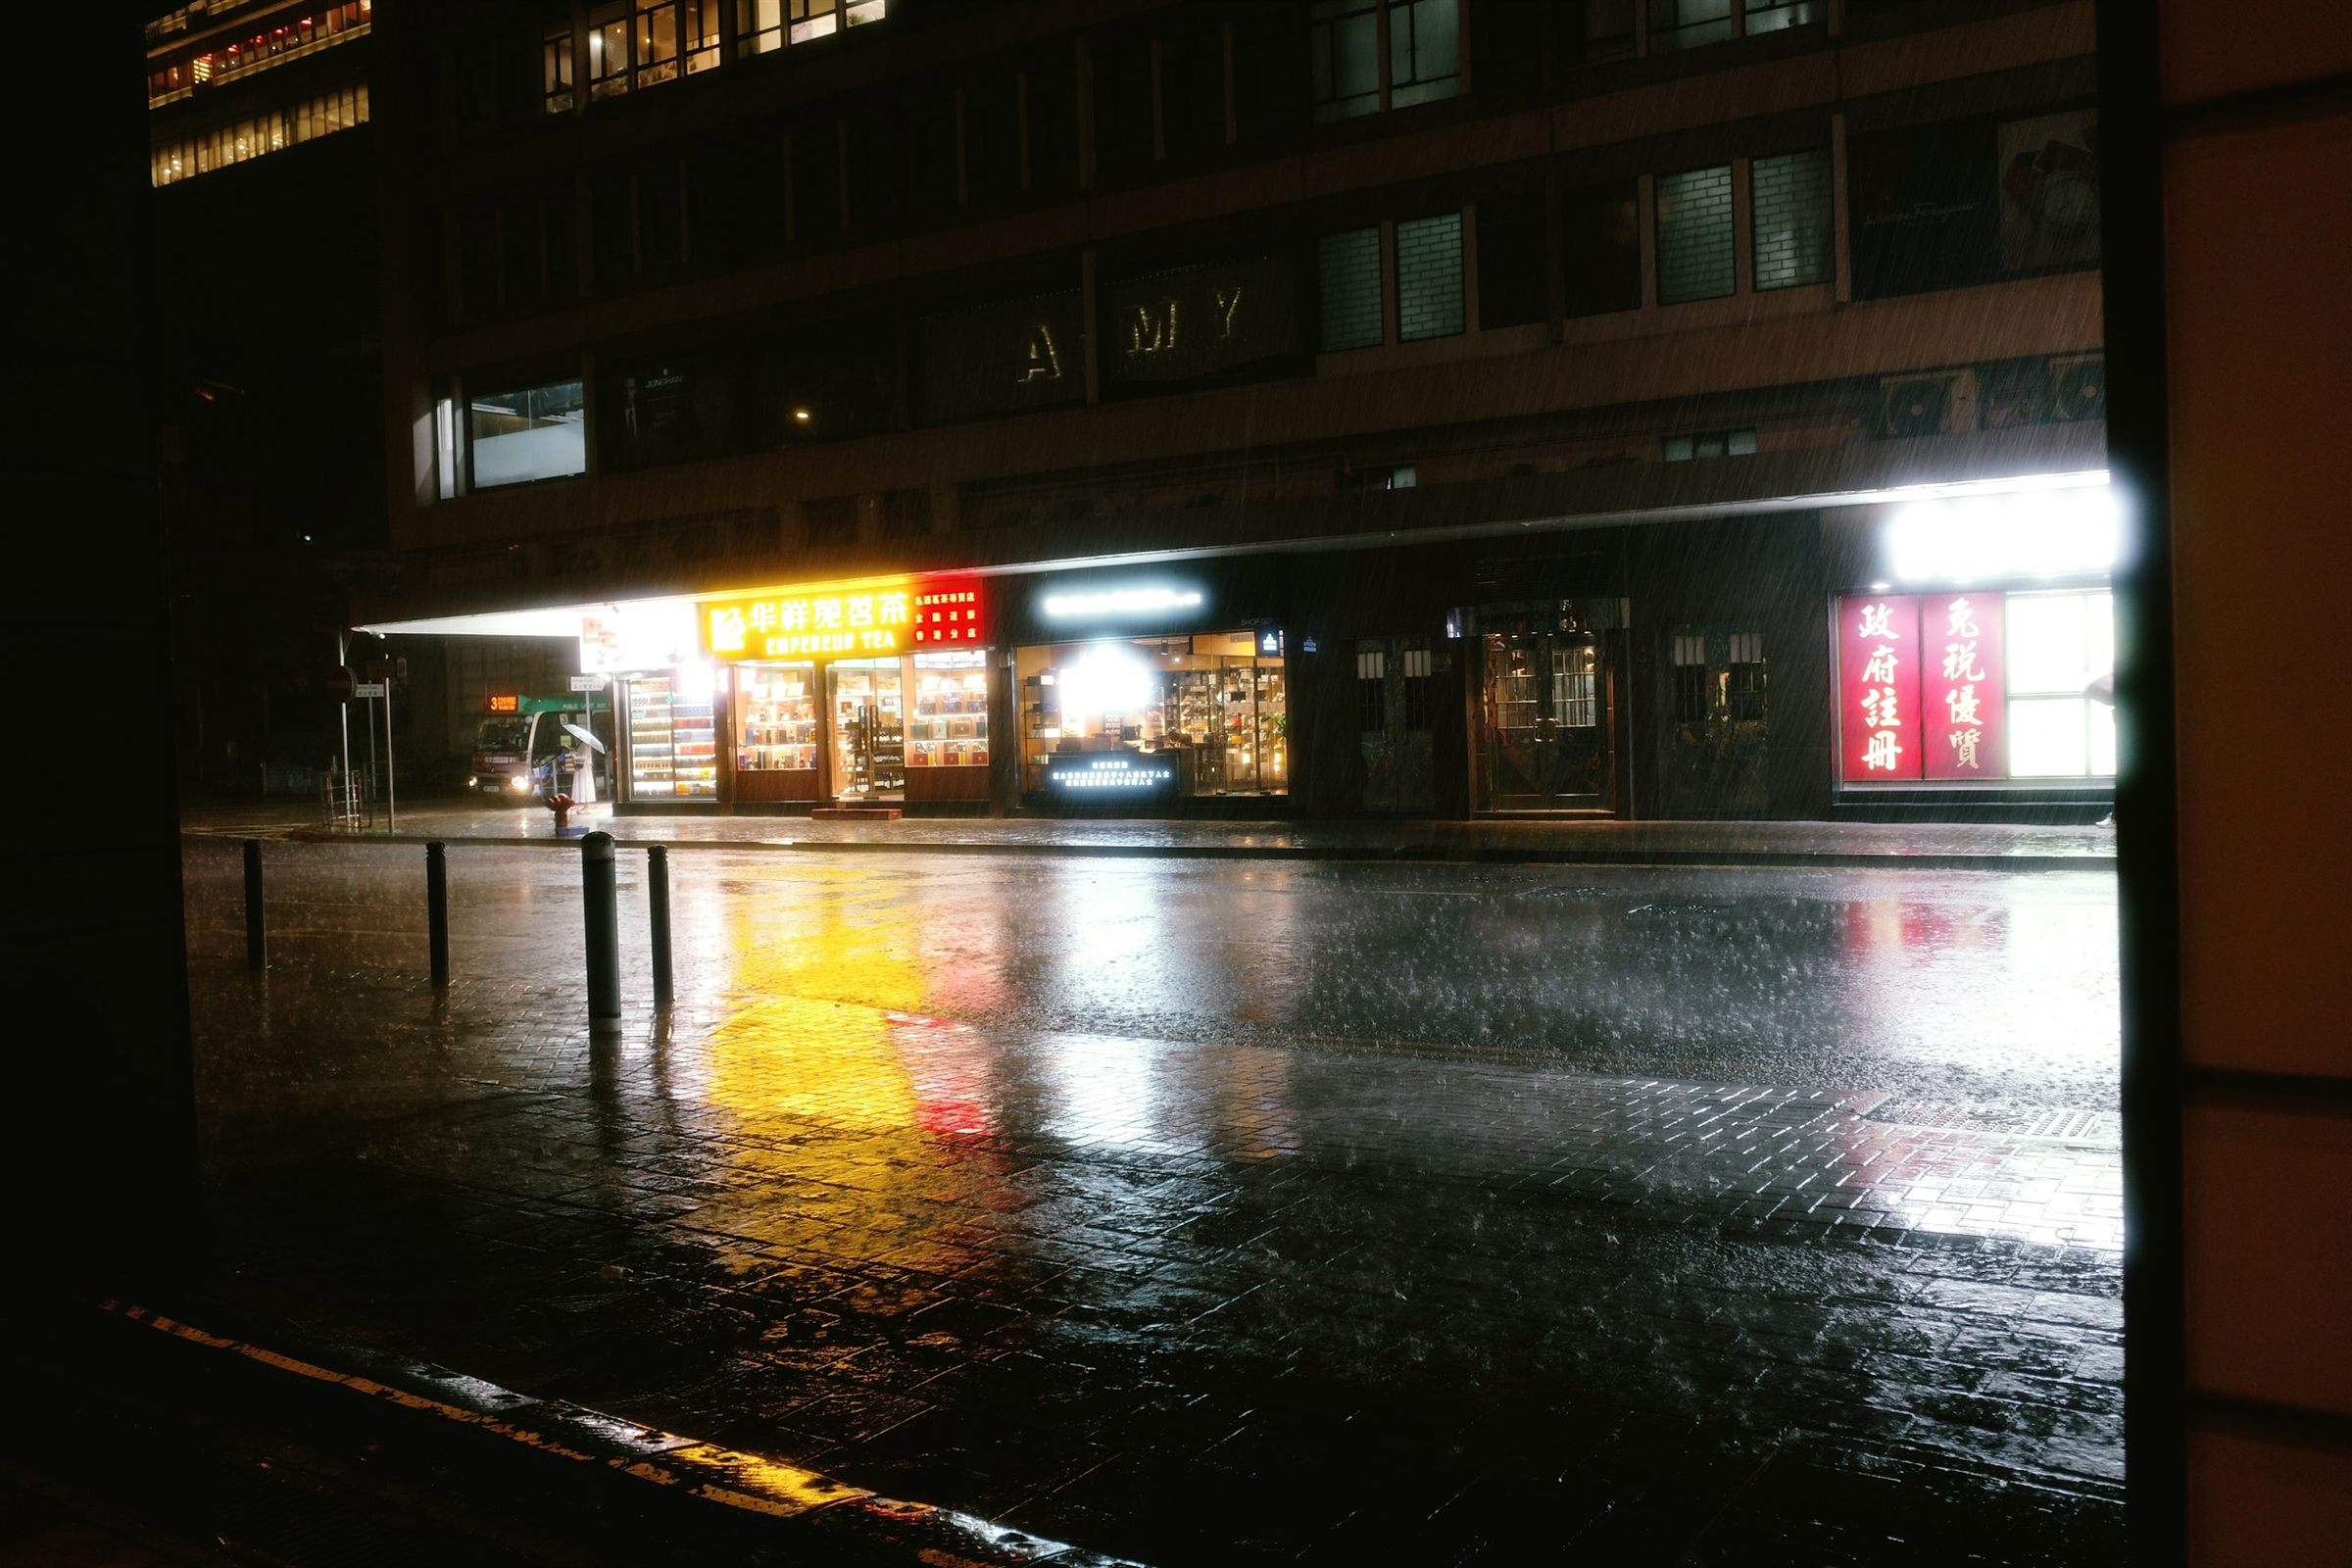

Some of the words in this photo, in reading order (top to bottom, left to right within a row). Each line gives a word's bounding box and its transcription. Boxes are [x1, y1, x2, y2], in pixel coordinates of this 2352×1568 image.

[645, 375, 685, 389] JUNGHAN
[751, 594, 906, 634] 华祥苑茗茶
[766, 634, 854, 655] EMPEREUR
[860, 631, 895, 649] TEA
[1858, 602, 1903, 771] 政府註冊
[490, 696, 498, 710] 3
